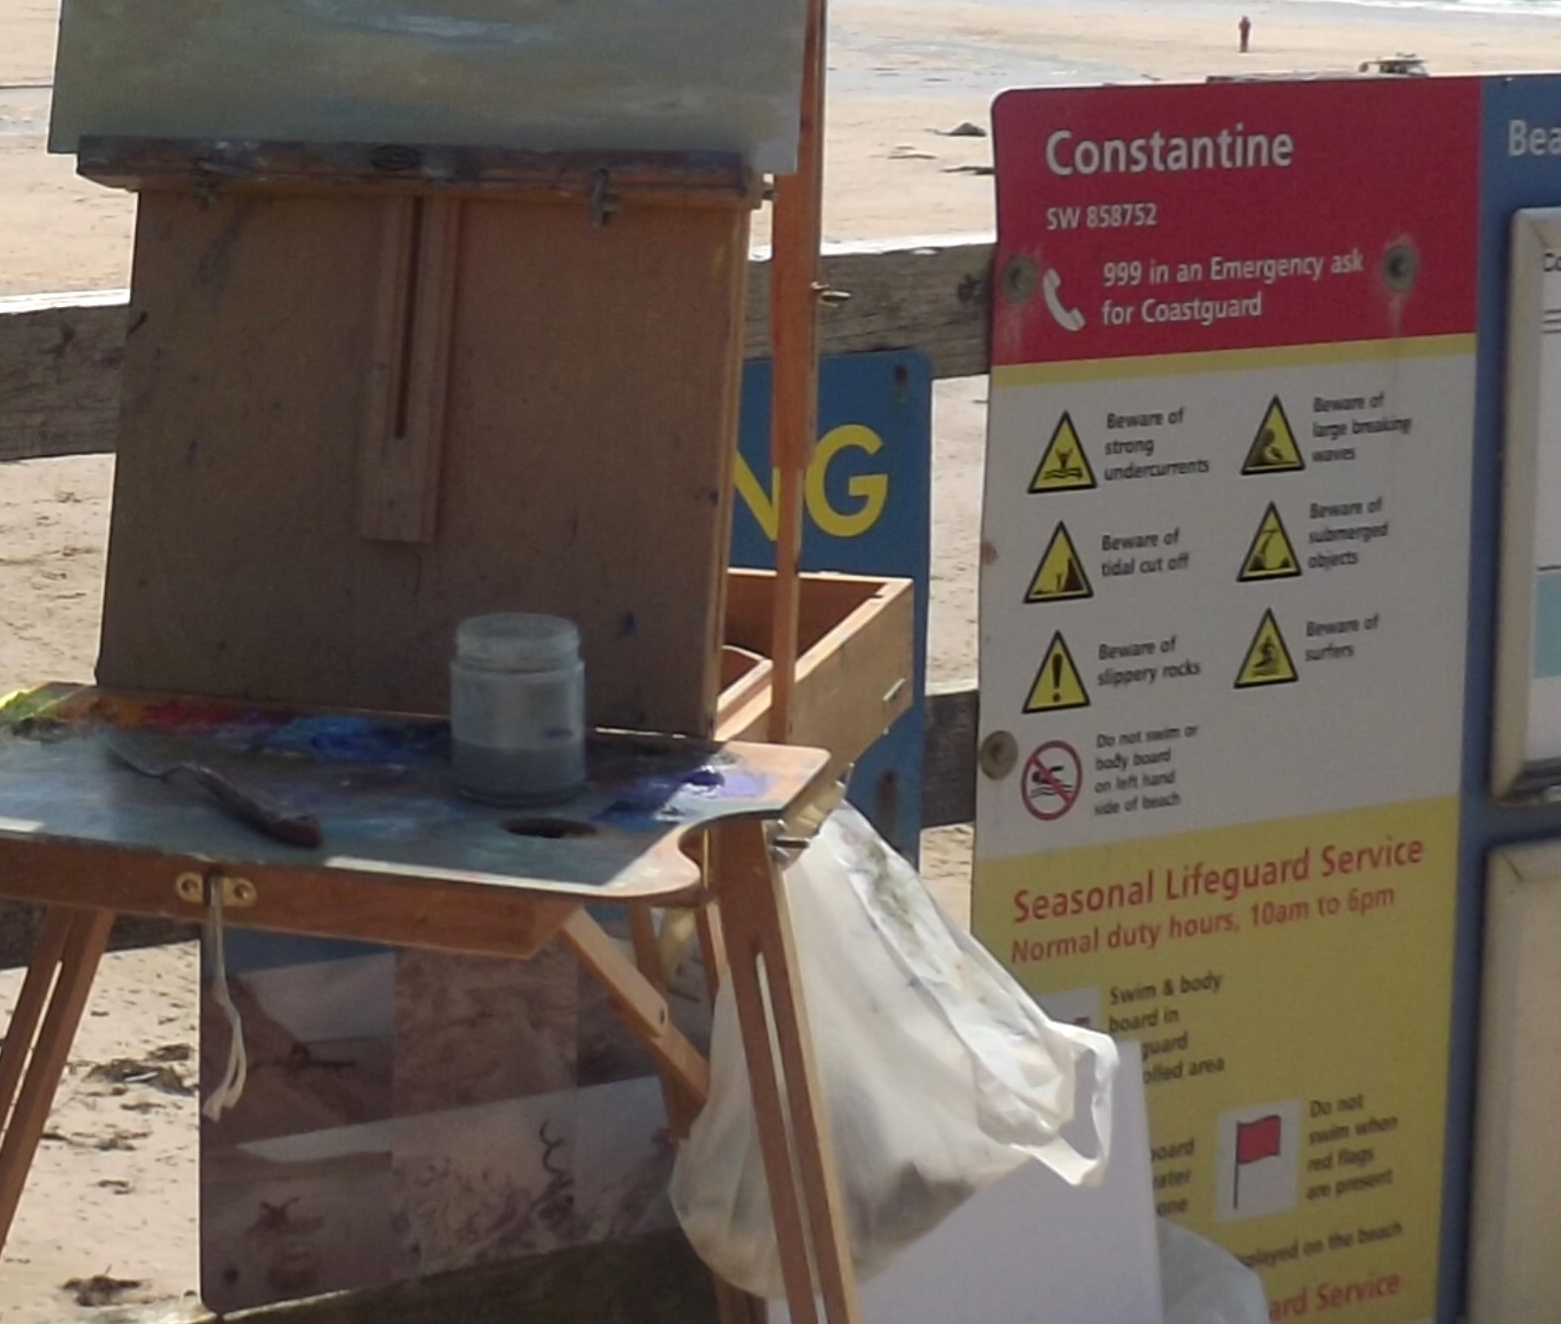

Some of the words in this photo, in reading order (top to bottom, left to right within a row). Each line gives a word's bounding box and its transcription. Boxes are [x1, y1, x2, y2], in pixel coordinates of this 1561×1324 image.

[1045, 122, 1294, 175] Constantine
[1046, 207, 1080, 230] SW
[1086, 203, 1157, 228] 858752
[1103, 260, 1141, 286] 999
[1149, 258, 1168, 283] in
[1176, 262, 1201, 282] an
[1210, 255, 1323, 284] Emergency
[1330, 248, 1364, 273] ask
[1102, 299, 1133, 326] for
[1140, 292, 1262, 325] Coastguard
[1313, 396, 1364, 413] Beware
[1370, 392, 1384, 408] of
[1106, 411, 1163, 429] Beware
[1168, 407, 1184, 424] of
[1312, 422, 1347, 440] large
[1352, 416, 1412, 435] breaking
[1105, 437, 1154, 456] strong
[1312, 447, 1356, 462] waves
[1104, 458, 1210, 481] undercurrents
[1310, 501, 1362, 519] Beware
[1367, 496, 1382, 512] of
[1101, 533, 1159, 551] Beware
[1163, 528, 1179, 545] of
[1309, 522, 1388, 544] submerged
[1101, 556, 1135, 576] tidal
[1139, 556, 1163, 573] cut
[1168, 551, 1189, 569] off
[1308, 549, 1358, 570] objects
[1306, 617, 1360, 637] Beware
[1364, 613, 1379, 629] of
[1098, 642, 1156, 660] Beware
[1160, 636, 1177, 653] of
[1305, 643, 1354, 662] surfers
[1097, 667, 1157, 686] slippery
[1163, 660, 1201, 678] rocks
[1096, 733, 1115, 748] Do
[1119, 730, 1142, 746] not
[1146, 726, 1181, 743] swim
[1184, 725, 1198, 737] or
[1095, 753, 1128, 771] body
[1133, 748, 1171, 766] board
[1094, 778, 1112, 793] on
[1116, 773, 1138, 790] left
[1142, 769, 1175, 788] hand
[1094, 798, 1119, 816] side
[1124, 795, 1139, 812] of
[1142, 792, 1181, 810] beach
[1013, 869, 1153, 923] Seasonal
[1166, 847, 1310, 901] Lifeguard
[1320, 835, 1423, 877] Service
[1011, 927, 1099, 964] Normal
[1107, 920, 1161, 949] duty
[1170, 911, 1239, 939] hours,
[1250, 898, 1309, 927] 10am
[1317, 895, 1339, 916] to
[1348, 885, 1396, 917] 6pm
[1110, 982, 1157, 1006] Swim
[1163, 977, 1174, 996] &
[1180, 970, 1221, 994] body
[1109, 1007, 1159, 1033] board
[1164, 1006, 1180, 1024] in
[1188, 1057, 1225, 1076] area
[1310, 1099, 1332, 1119] Do
[1337, 1093, 1363, 1113] not
[1308, 1123, 1349, 1146] swim
[1355, 1115, 1398, 1136] when
[1306, 1153, 1332, 1173] red
[1337, 1147, 1374, 1168] flags
[1305, 1183, 1330, 1201] are
[1335, 1168, 1393, 1197] present
[1303, 1239, 1323, 1256] on
[1328, 1231, 1353, 1250] the
[1358, 1222, 1402, 1245] beach
[1316, 1271, 1401, 1311] Service
